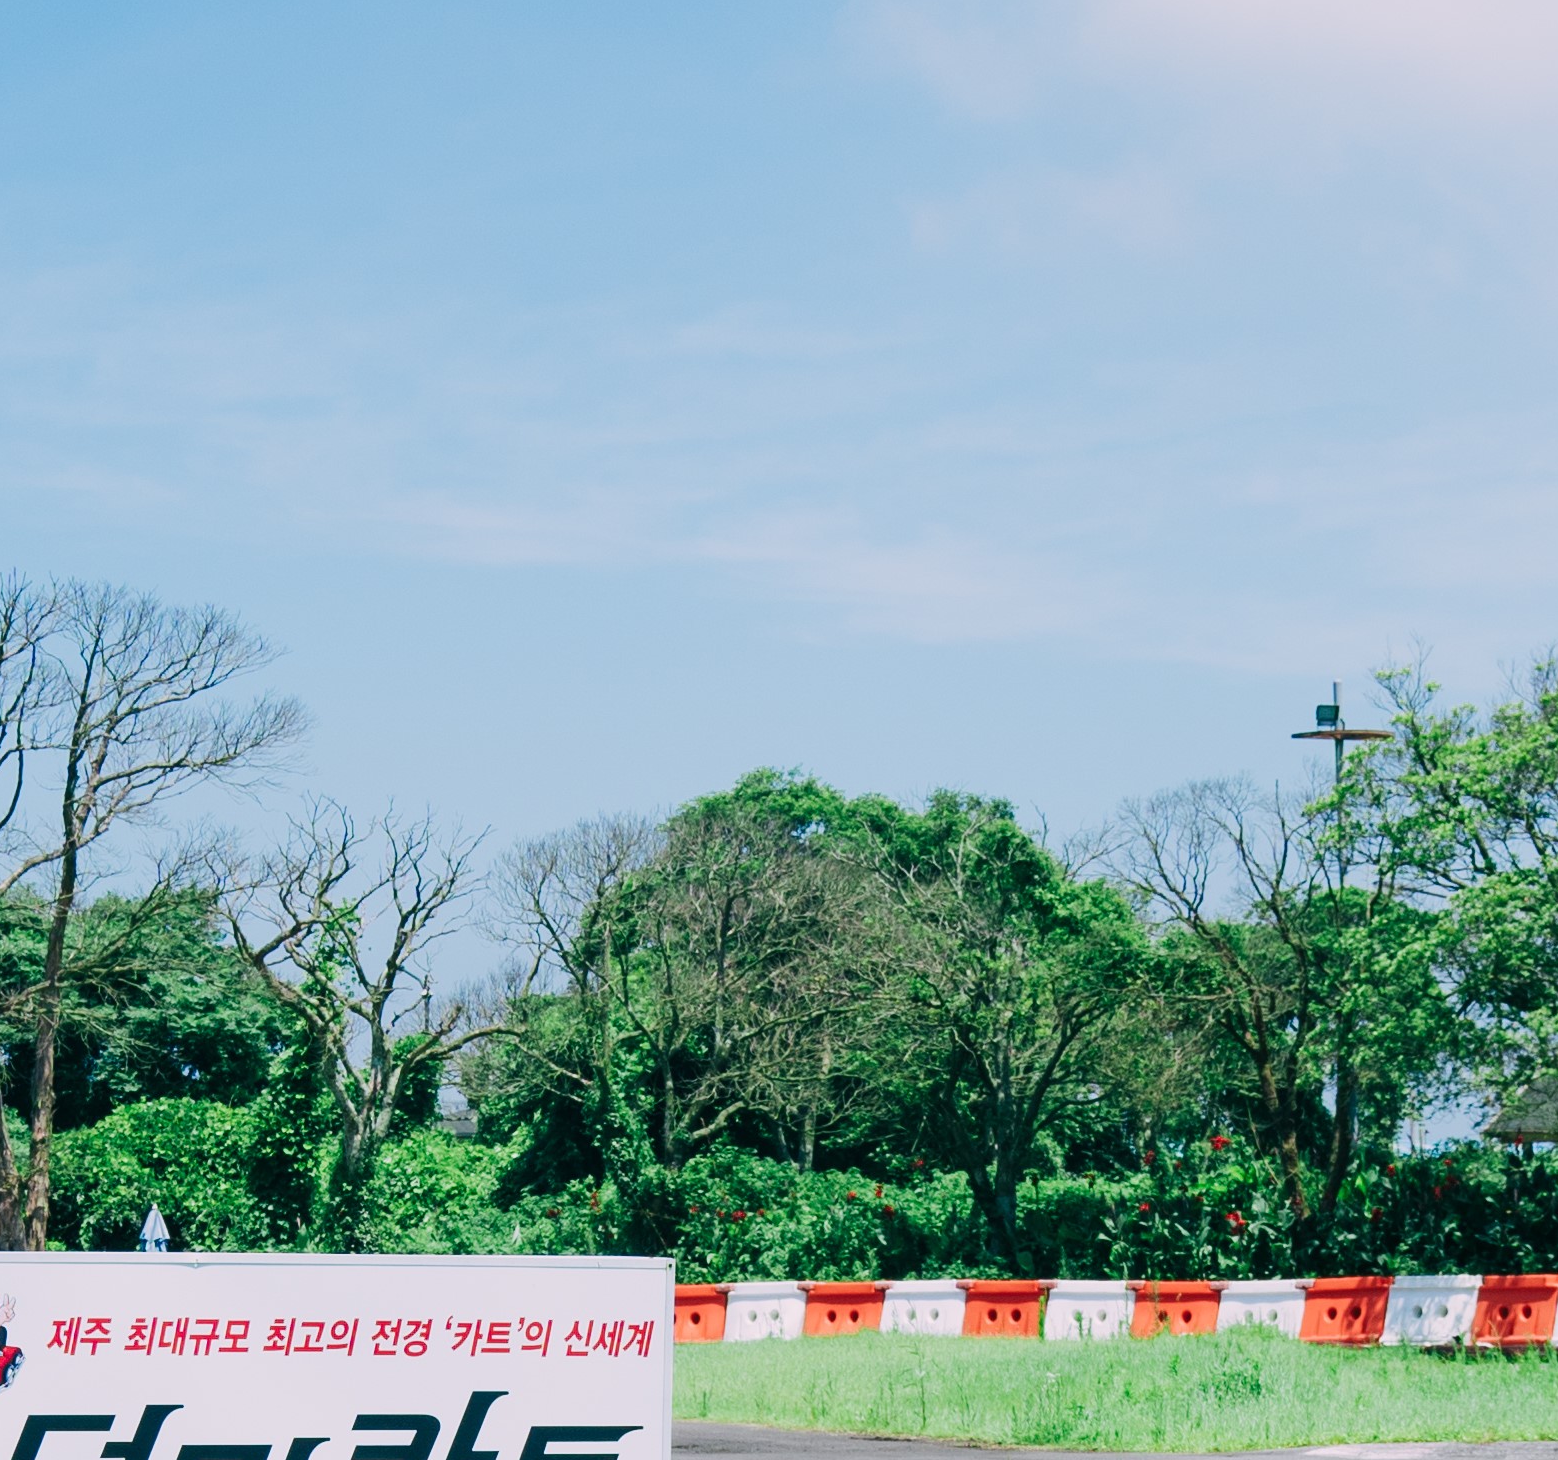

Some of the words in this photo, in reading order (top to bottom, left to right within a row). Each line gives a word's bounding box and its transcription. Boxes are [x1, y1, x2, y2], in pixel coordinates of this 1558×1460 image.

[47, 1317, 111, 1355] 제주
[124, 1317, 250, 1356] 최대규모
[263, 1318, 359, 1356] 최고의
[372, 1319, 433, 1357] 전경
[565, 1320, 655, 1357] 신세계
